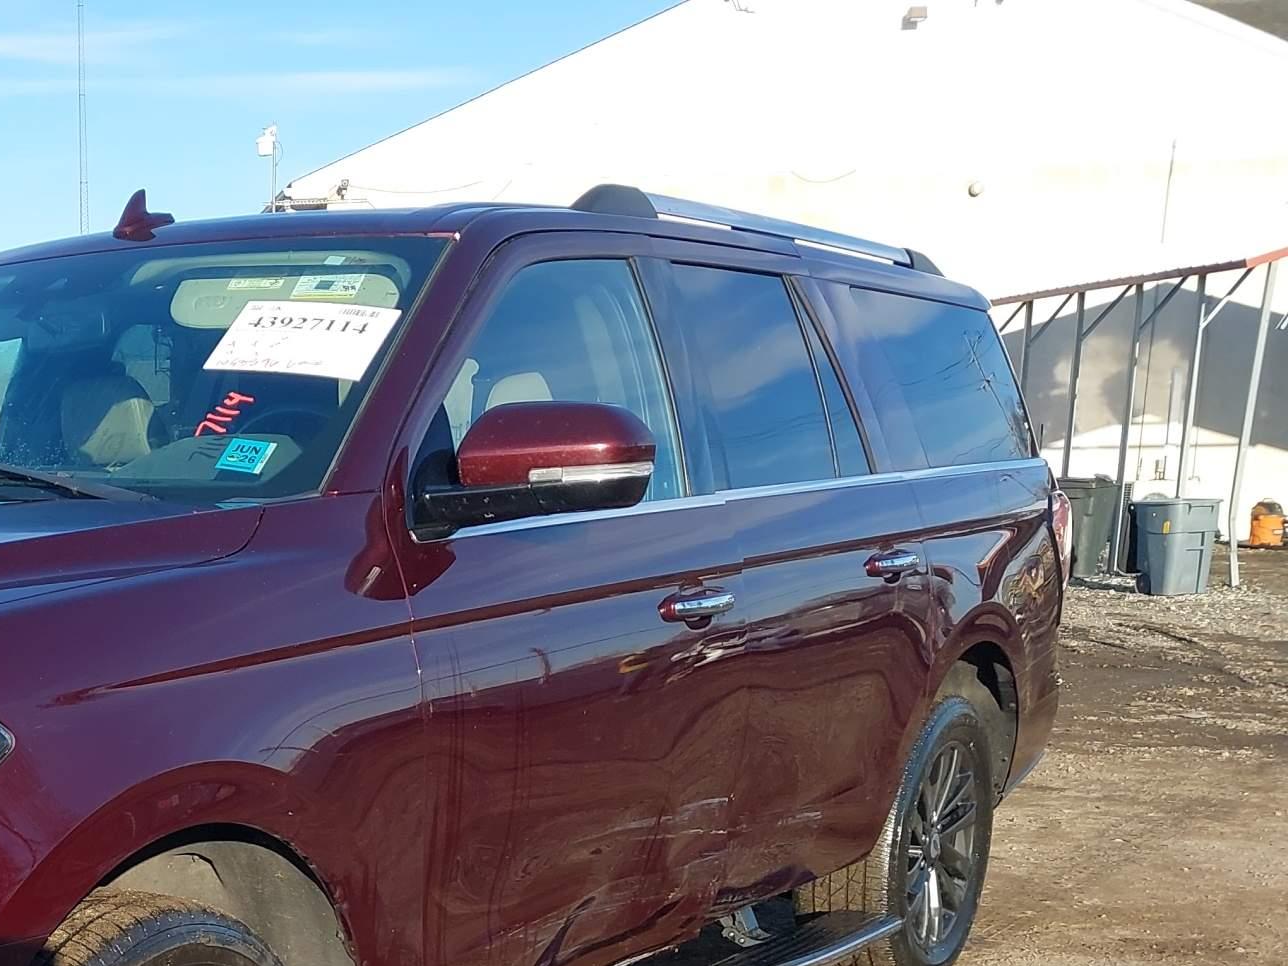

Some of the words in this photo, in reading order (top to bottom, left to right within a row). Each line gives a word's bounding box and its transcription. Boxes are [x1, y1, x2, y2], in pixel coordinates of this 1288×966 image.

[248, 315, 369, 334] 43927114
[232, 444, 261, 455] JUN
[240, 454, 256, 464] 26
